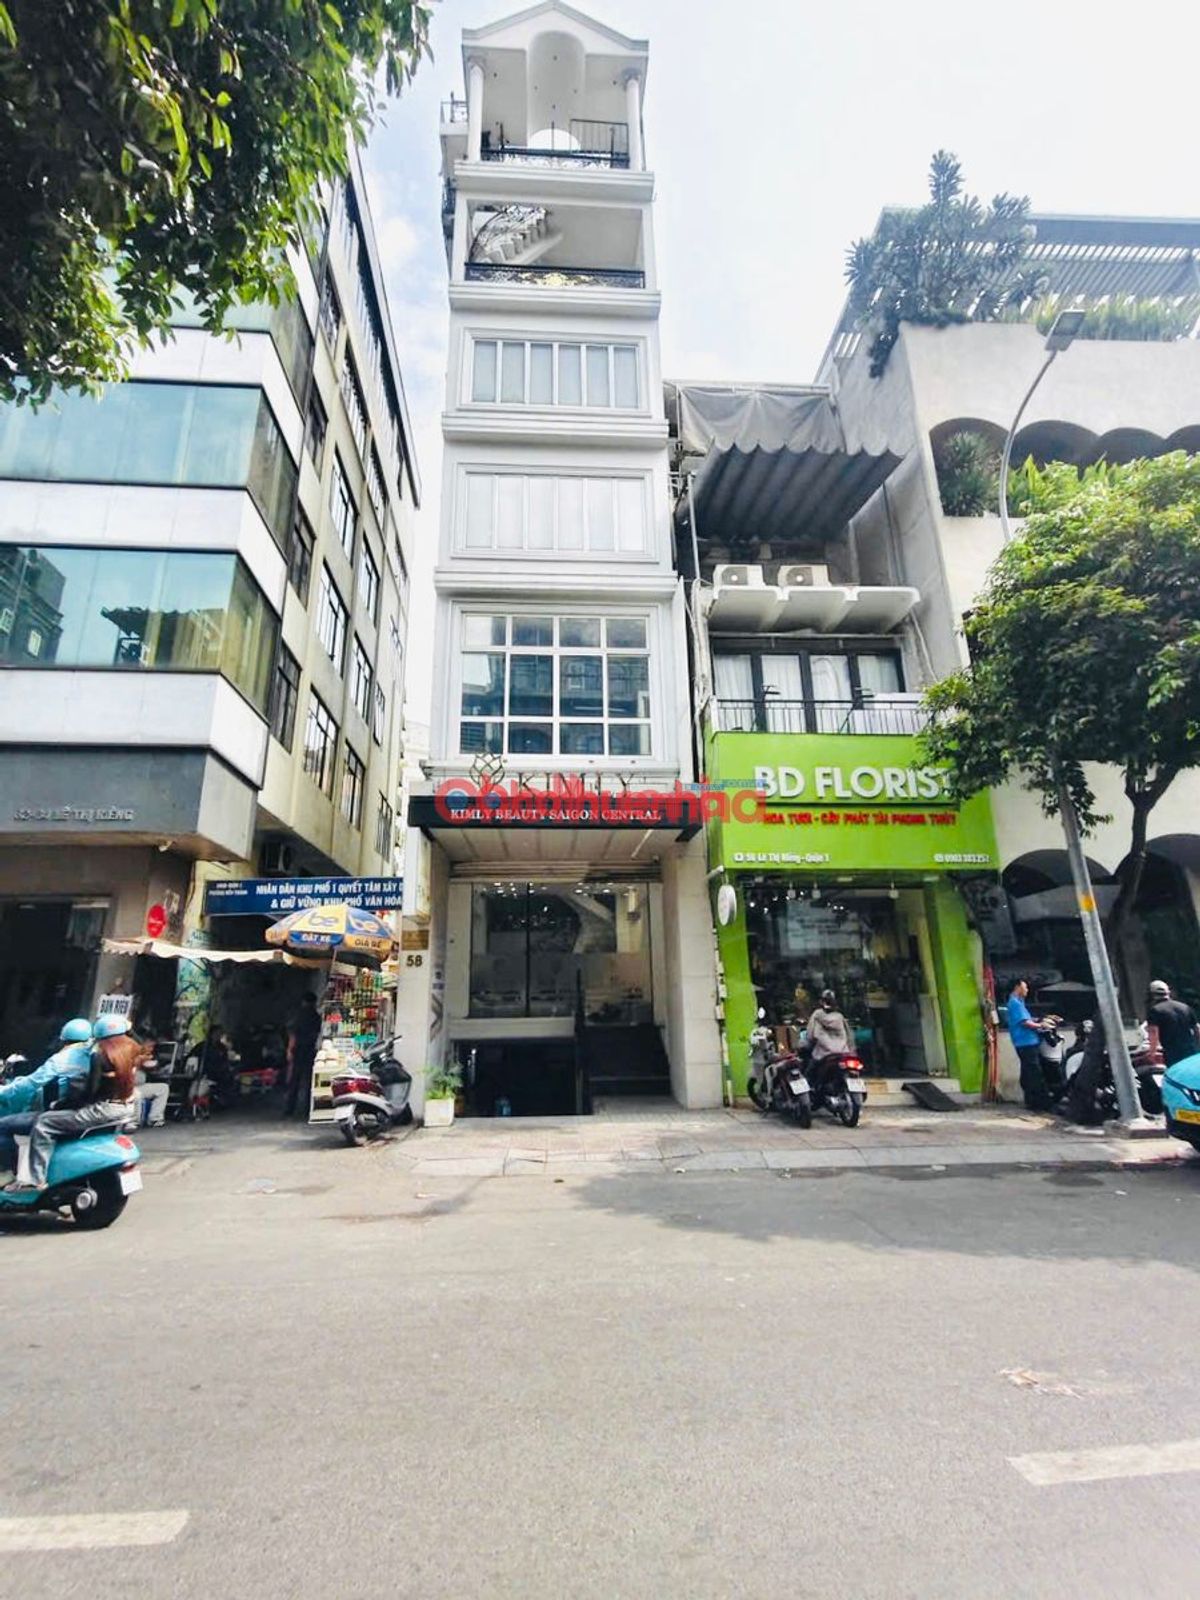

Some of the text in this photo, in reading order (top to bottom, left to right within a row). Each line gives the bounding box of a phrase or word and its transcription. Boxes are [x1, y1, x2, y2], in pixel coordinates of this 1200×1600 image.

[755, 766, 805, 798] BD
[495, 809, 545, 820] BEAUTY
[548, 809, 599, 820] SAIGON
[601, 809, 661, 821] CENTRAL
[255, 883, 278, 895] NHÂN
[278, 882, 295, 894] DÂN
[296, 883, 313, 894] KHU
[314, 880, 331, 894] PHỐ
[338, 880, 363, 895] QUYẾT
[364, 880, 381, 893] TÂM
[382, 881, 398, 893] XÂY
[270, 899, 278, 908] &
[406, 954, 423, 968] 58
